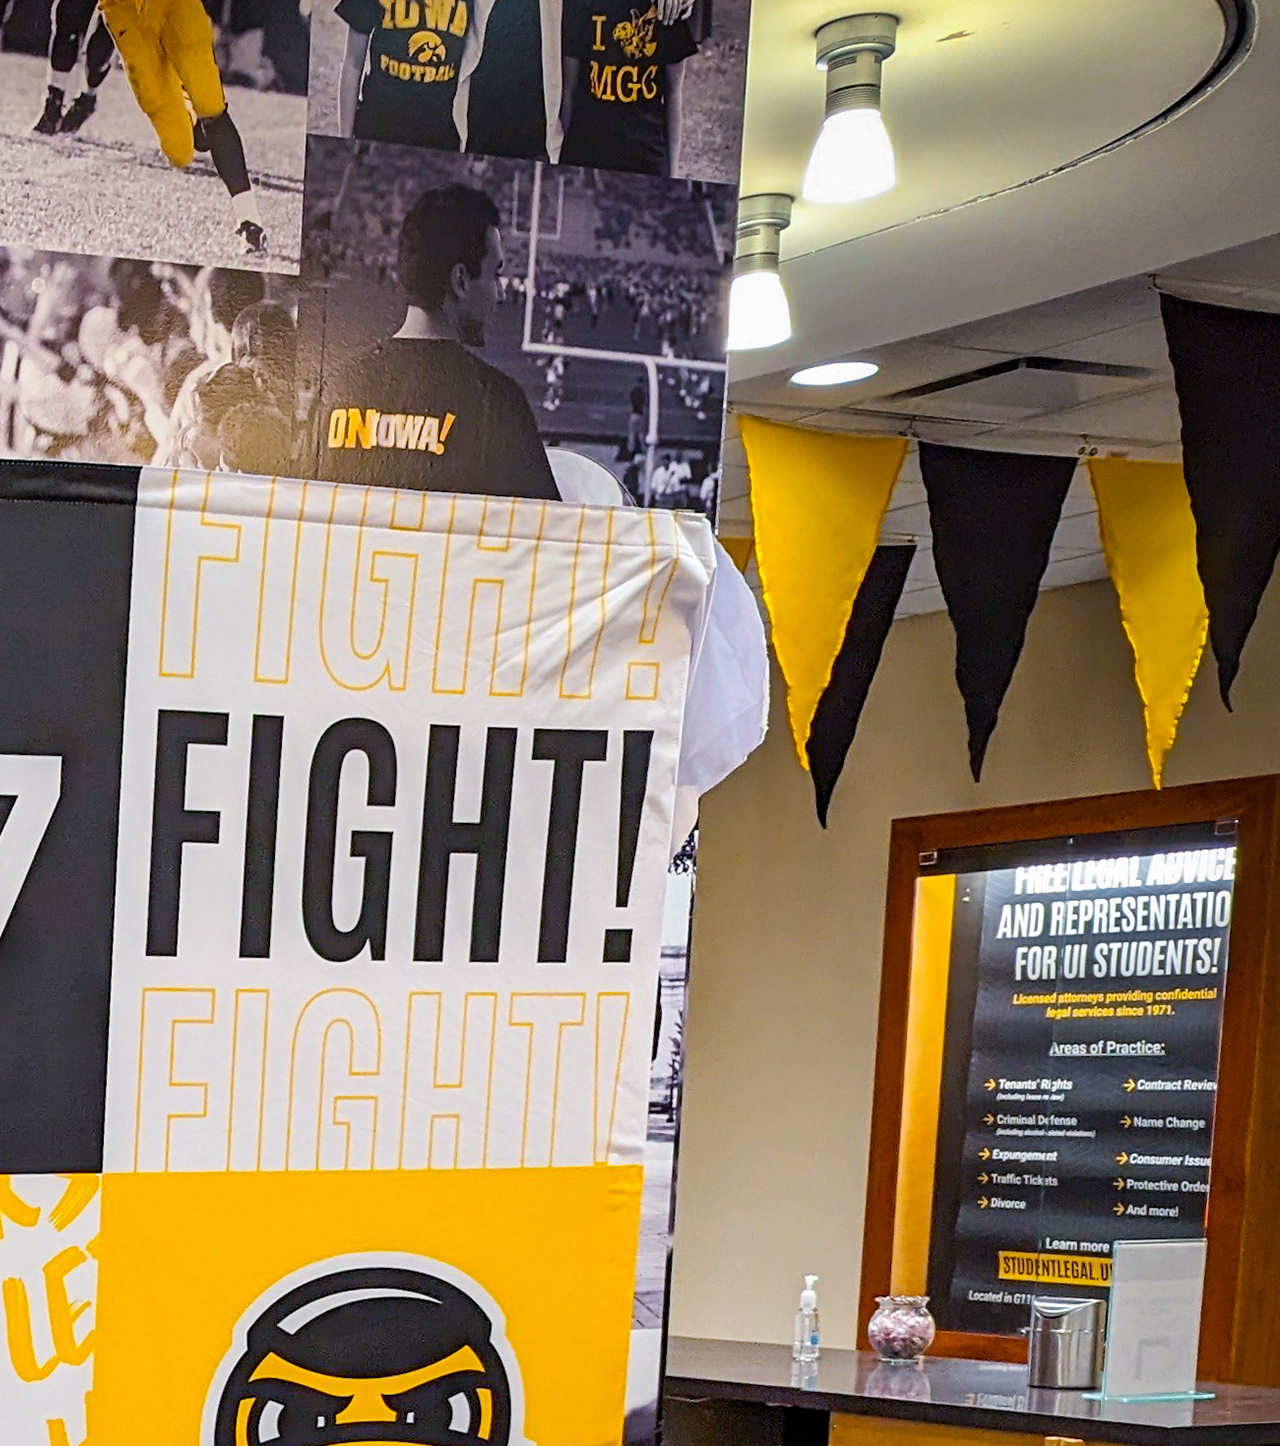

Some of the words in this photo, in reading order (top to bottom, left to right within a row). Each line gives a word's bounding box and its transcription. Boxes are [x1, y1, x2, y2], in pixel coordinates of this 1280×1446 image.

[145, 709, 655, 964] FIGHT!
[996, 901, 1045, 940] AND
[1015, 945, 1058, 982] FOR
[1063, 943, 1088, 980] UI
[1093, 937, 1222, 978] STUDENTS!
[1012, 991, 1056, 1005] Licensed
[1058, 991, 1104, 1006] attorneys
[1105, 989, 1153, 1004] providing
[1155, 987, 1217, 1001] confidential
[1045, 1006, 1071, 1019] legal
[1072, 1005, 1114, 1017] services
[1116, 1005, 1144, 1017] since
[1146, 1004, 1176, 1016] 1971.
[1050, 1041, 1087, 1056] Areas
[1092, 1040, 1104, 1055] of
[1106, 1040, 1165, 1056] Practice:
[998, 1078, 1040, 1090] Tenants'
[1040, 1078, 1073, 1092] Rights
[1137, 1079, 1181, 1090] Contract
[997, 1114, 1036, 1125] Criminal
[1133, 1117, 1164, 1128] Name
[1165, 1116, 1206, 1131] Change
[992, 1148, 1058, 1163] Expungement
[1129, 1153, 1183, 1166] Consumer
[991, 1173, 1021, 1185] Traffic
[1126, 1178, 1179, 1191] Protective
[991, 1197, 1026, 1209] Divorce
[1126, 1204, 1147, 1216] And
[1148, 1206, 1179, 1218] more!
[1045, 1237, 1078, 1251] Learn
[1079, 1241, 1110, 1253] more
[1002, 1256, 1113, 1281] STUDENTLEGAL.U
[968, 1290, 1003, 1303] Located
[1003, 1292, 1013, 1303] in
